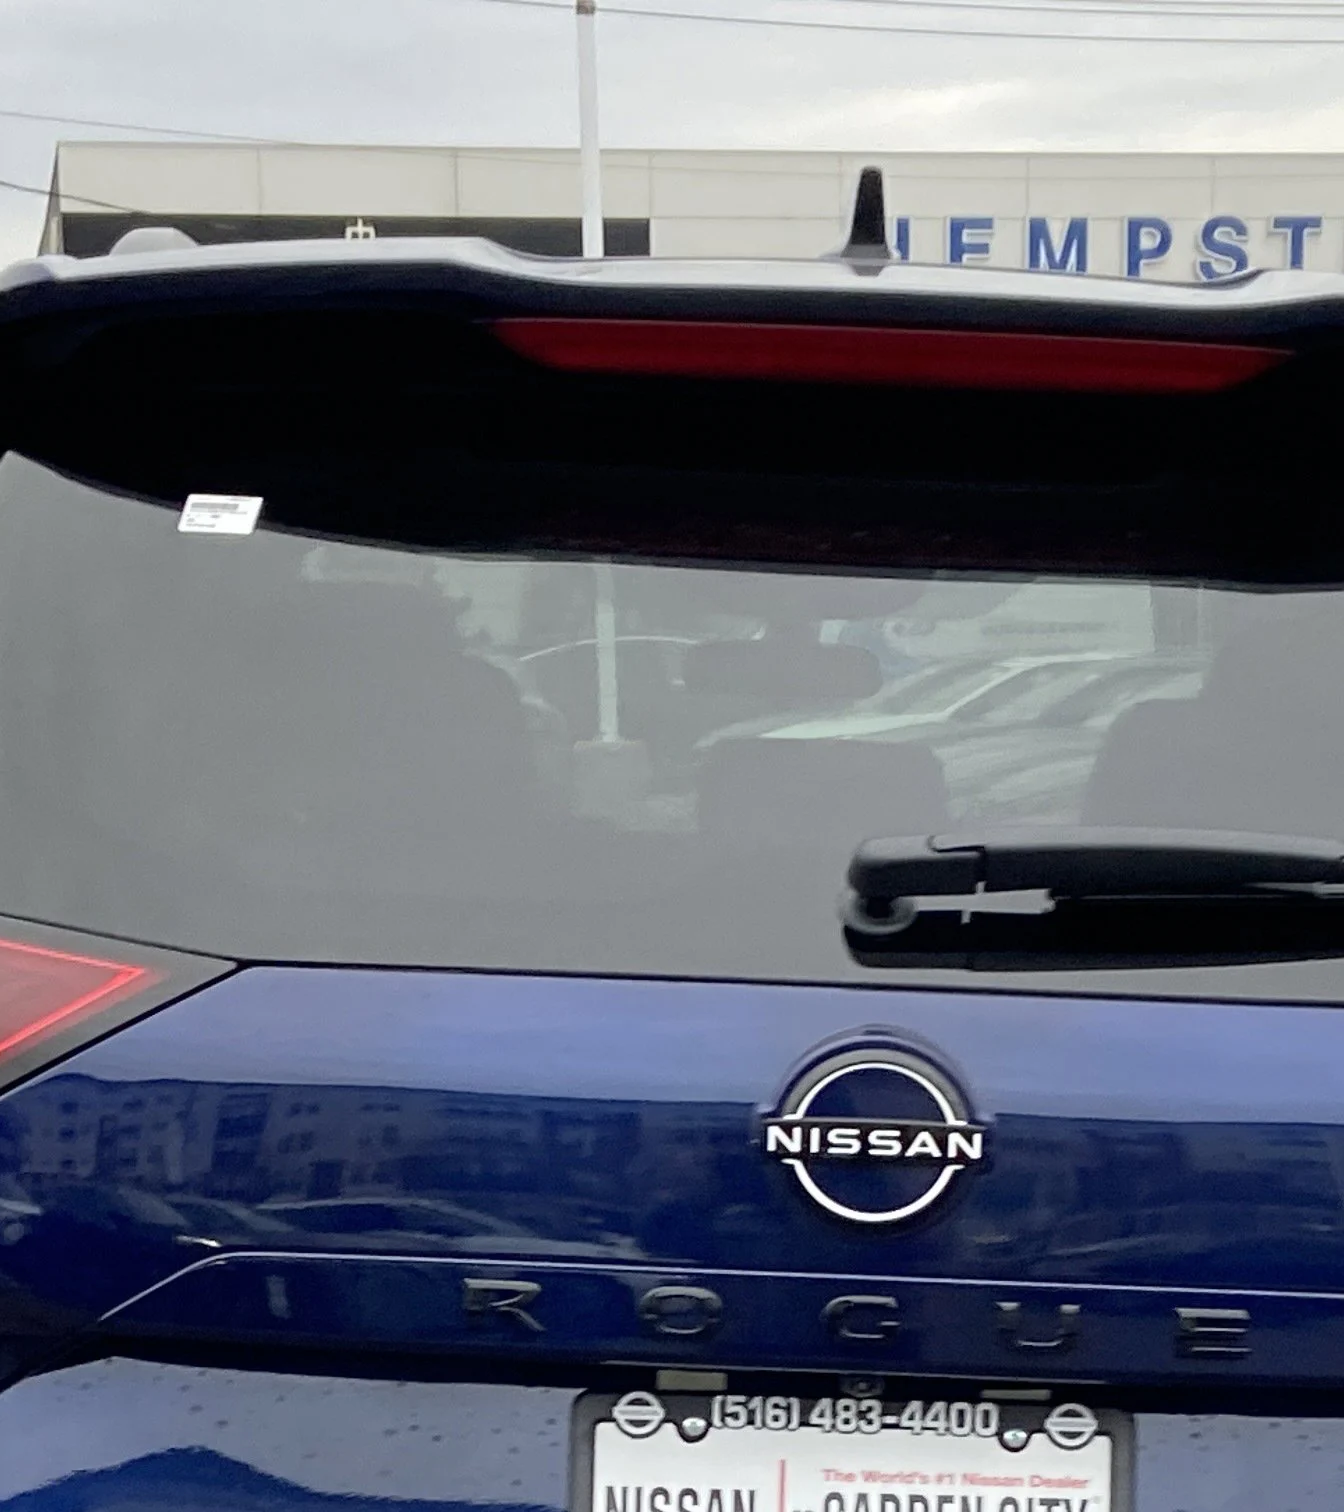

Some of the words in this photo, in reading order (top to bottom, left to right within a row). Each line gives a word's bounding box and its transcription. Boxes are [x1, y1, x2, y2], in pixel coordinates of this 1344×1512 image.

[766, 1125, 983, 1159] NISSAN
[462, 1277, 1254, 1355] ROGUE
[711, 1395, 800, 1430] (516)
[809, 1398, 999, 1436] 483-4400
[821, 1468, 856, 1482] The
